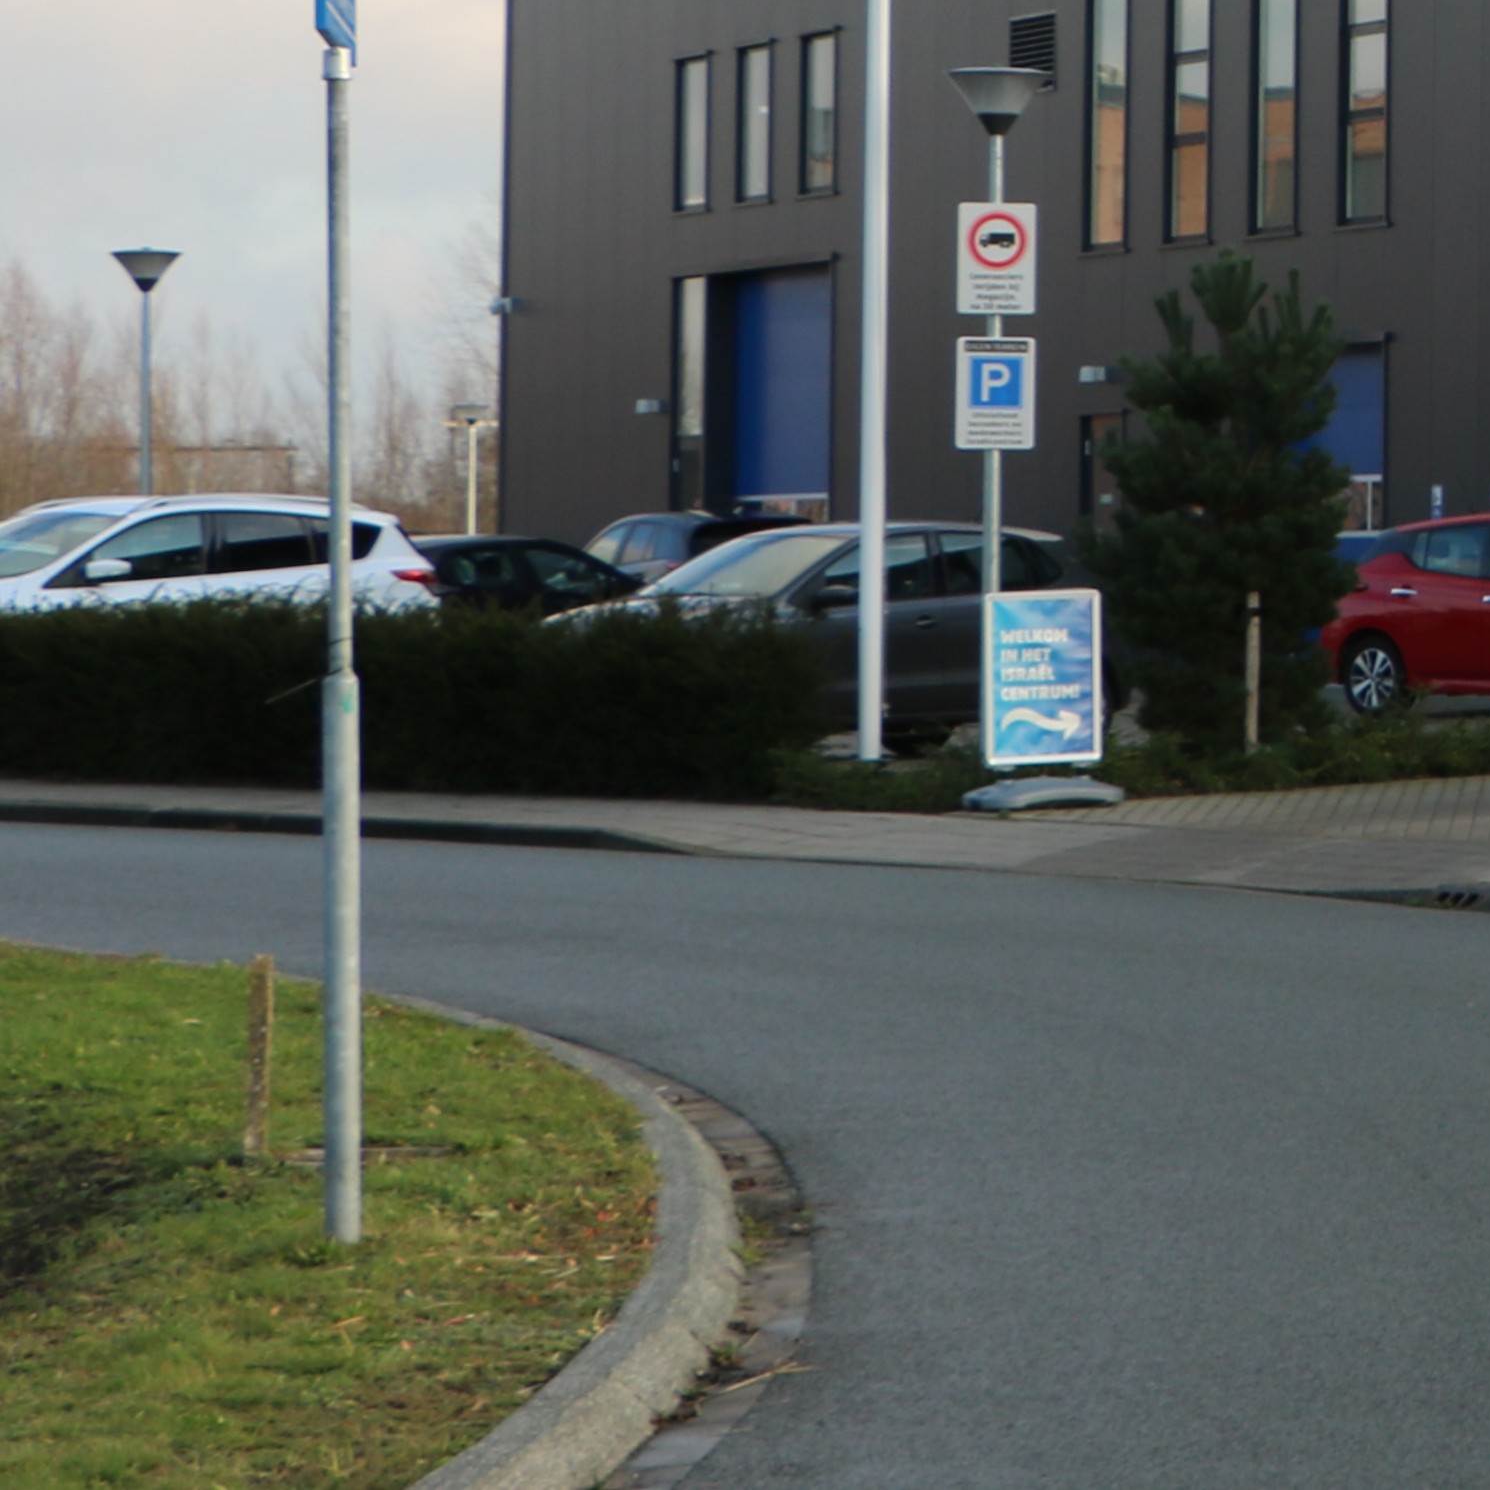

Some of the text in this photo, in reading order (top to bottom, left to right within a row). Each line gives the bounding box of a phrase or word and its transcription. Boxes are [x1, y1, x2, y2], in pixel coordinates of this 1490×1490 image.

[980, 363, 1011, 402] P
[1000, 628, 1070, 644] WELKOM
[1001, 648, 1053, 662] IN HET
[1001, 663, 1055, 682] ISRAËL
[1001, 684, 1081, 702] CENTRUM!
